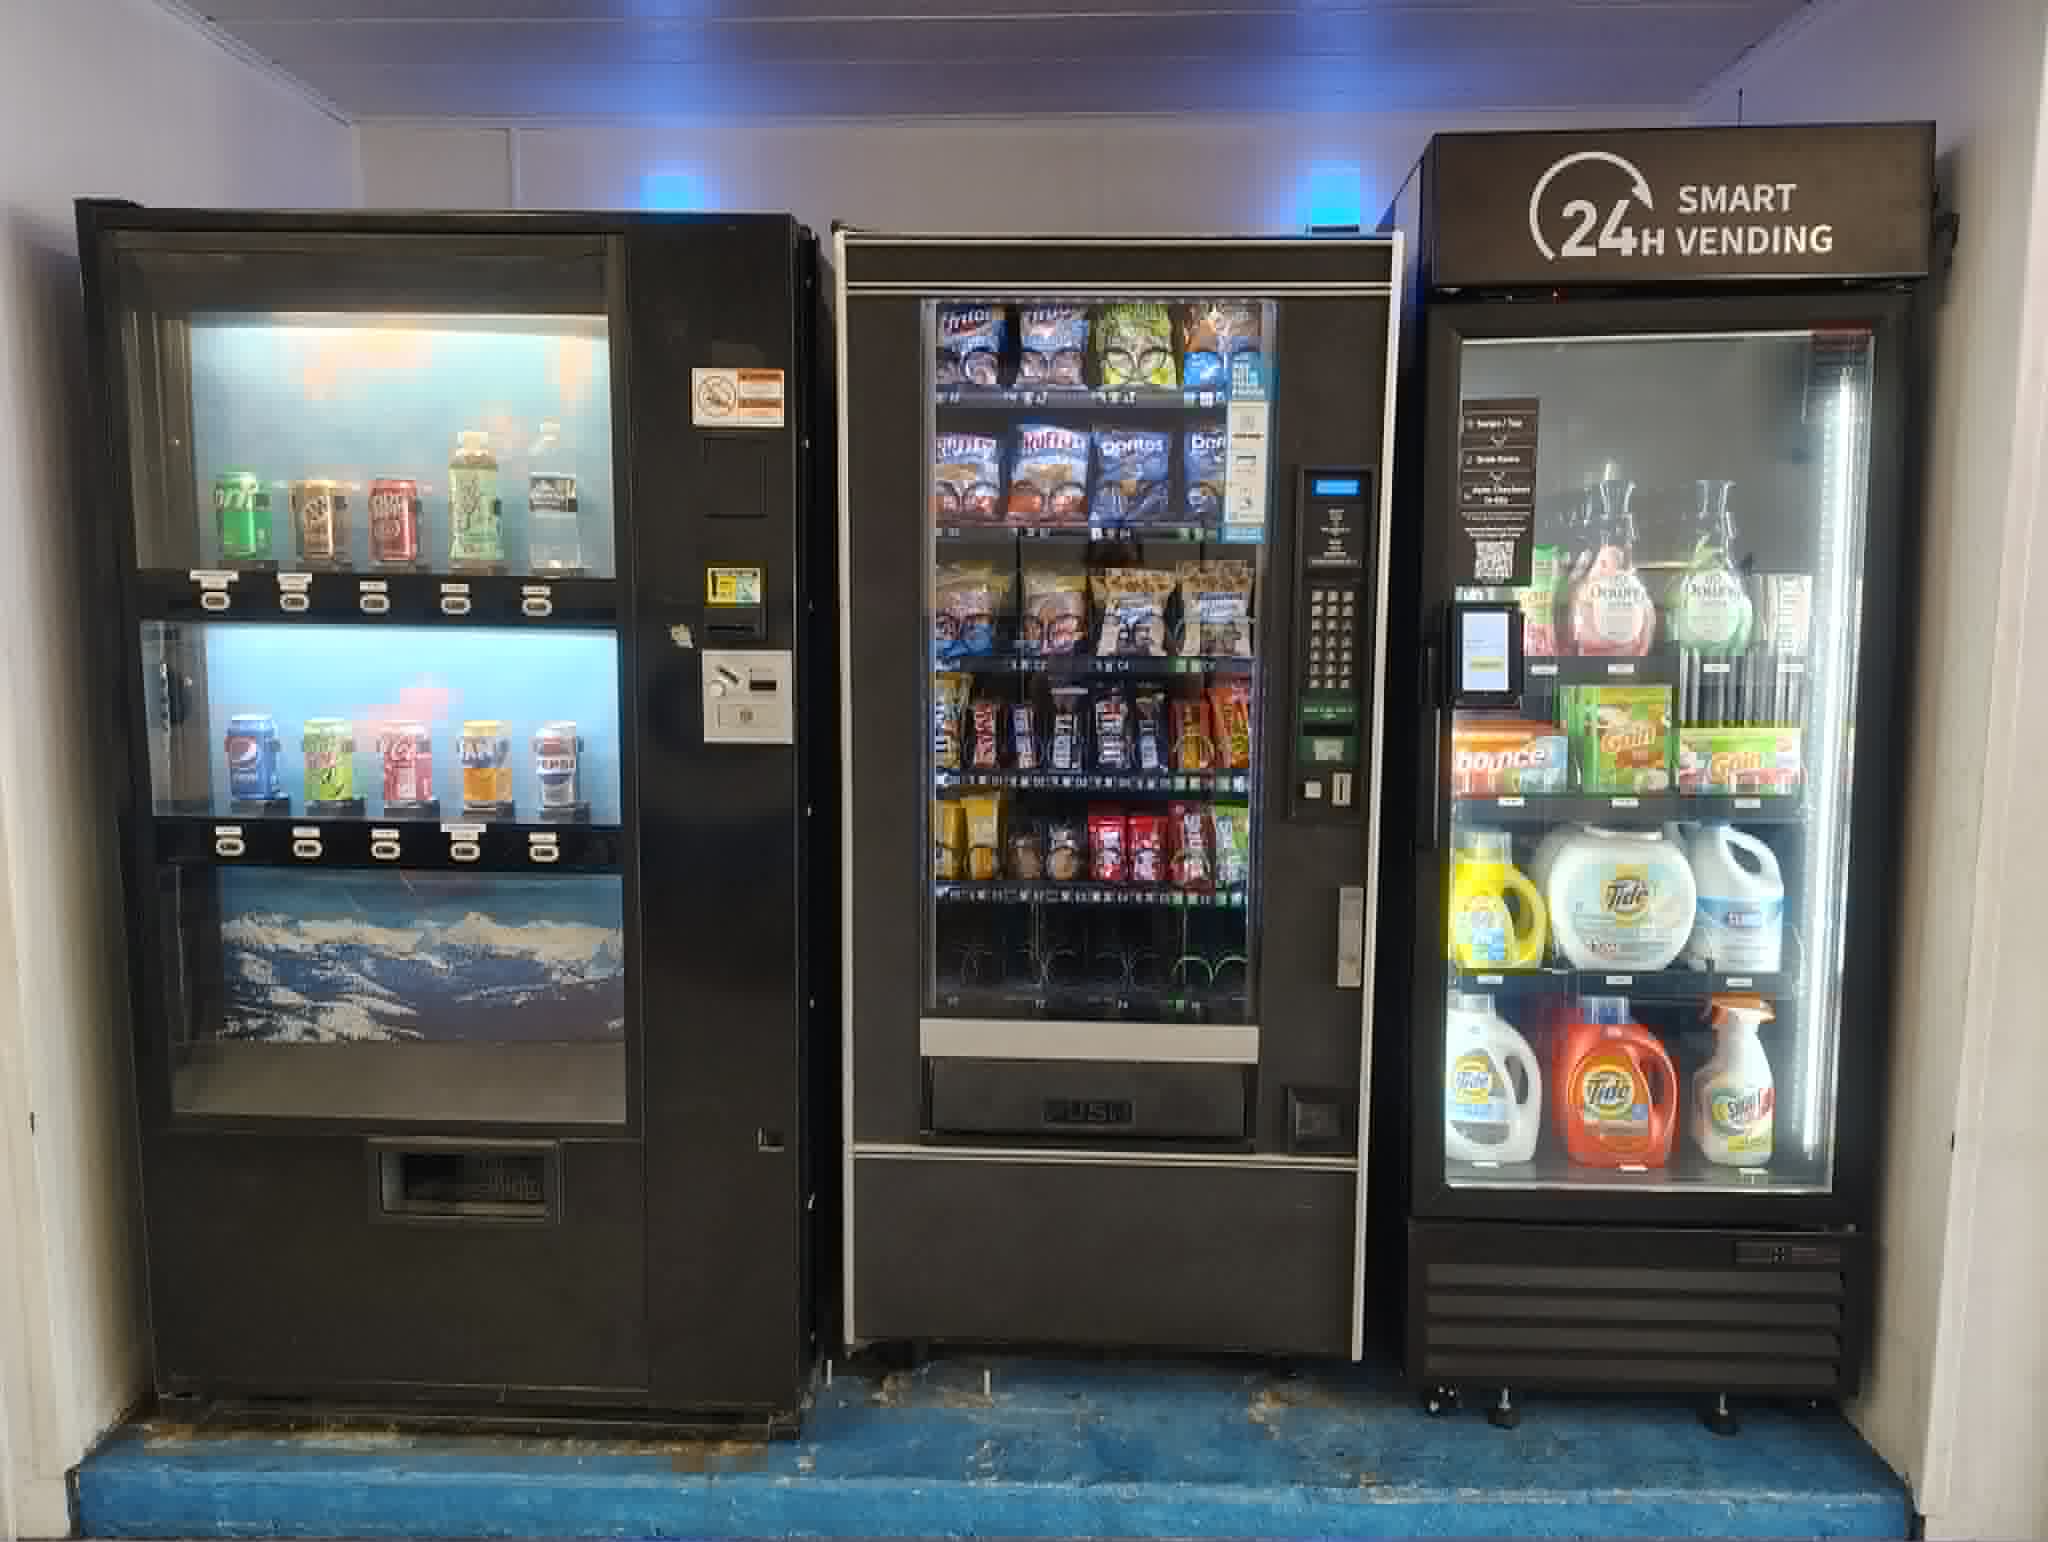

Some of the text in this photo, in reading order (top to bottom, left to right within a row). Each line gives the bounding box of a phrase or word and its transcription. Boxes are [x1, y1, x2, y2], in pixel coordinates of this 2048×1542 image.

[1678, 182, 1797, 214] SMART
[1675, 224, 1833, 256] VENDING
[1606, 882, 1650, 910] Tide
